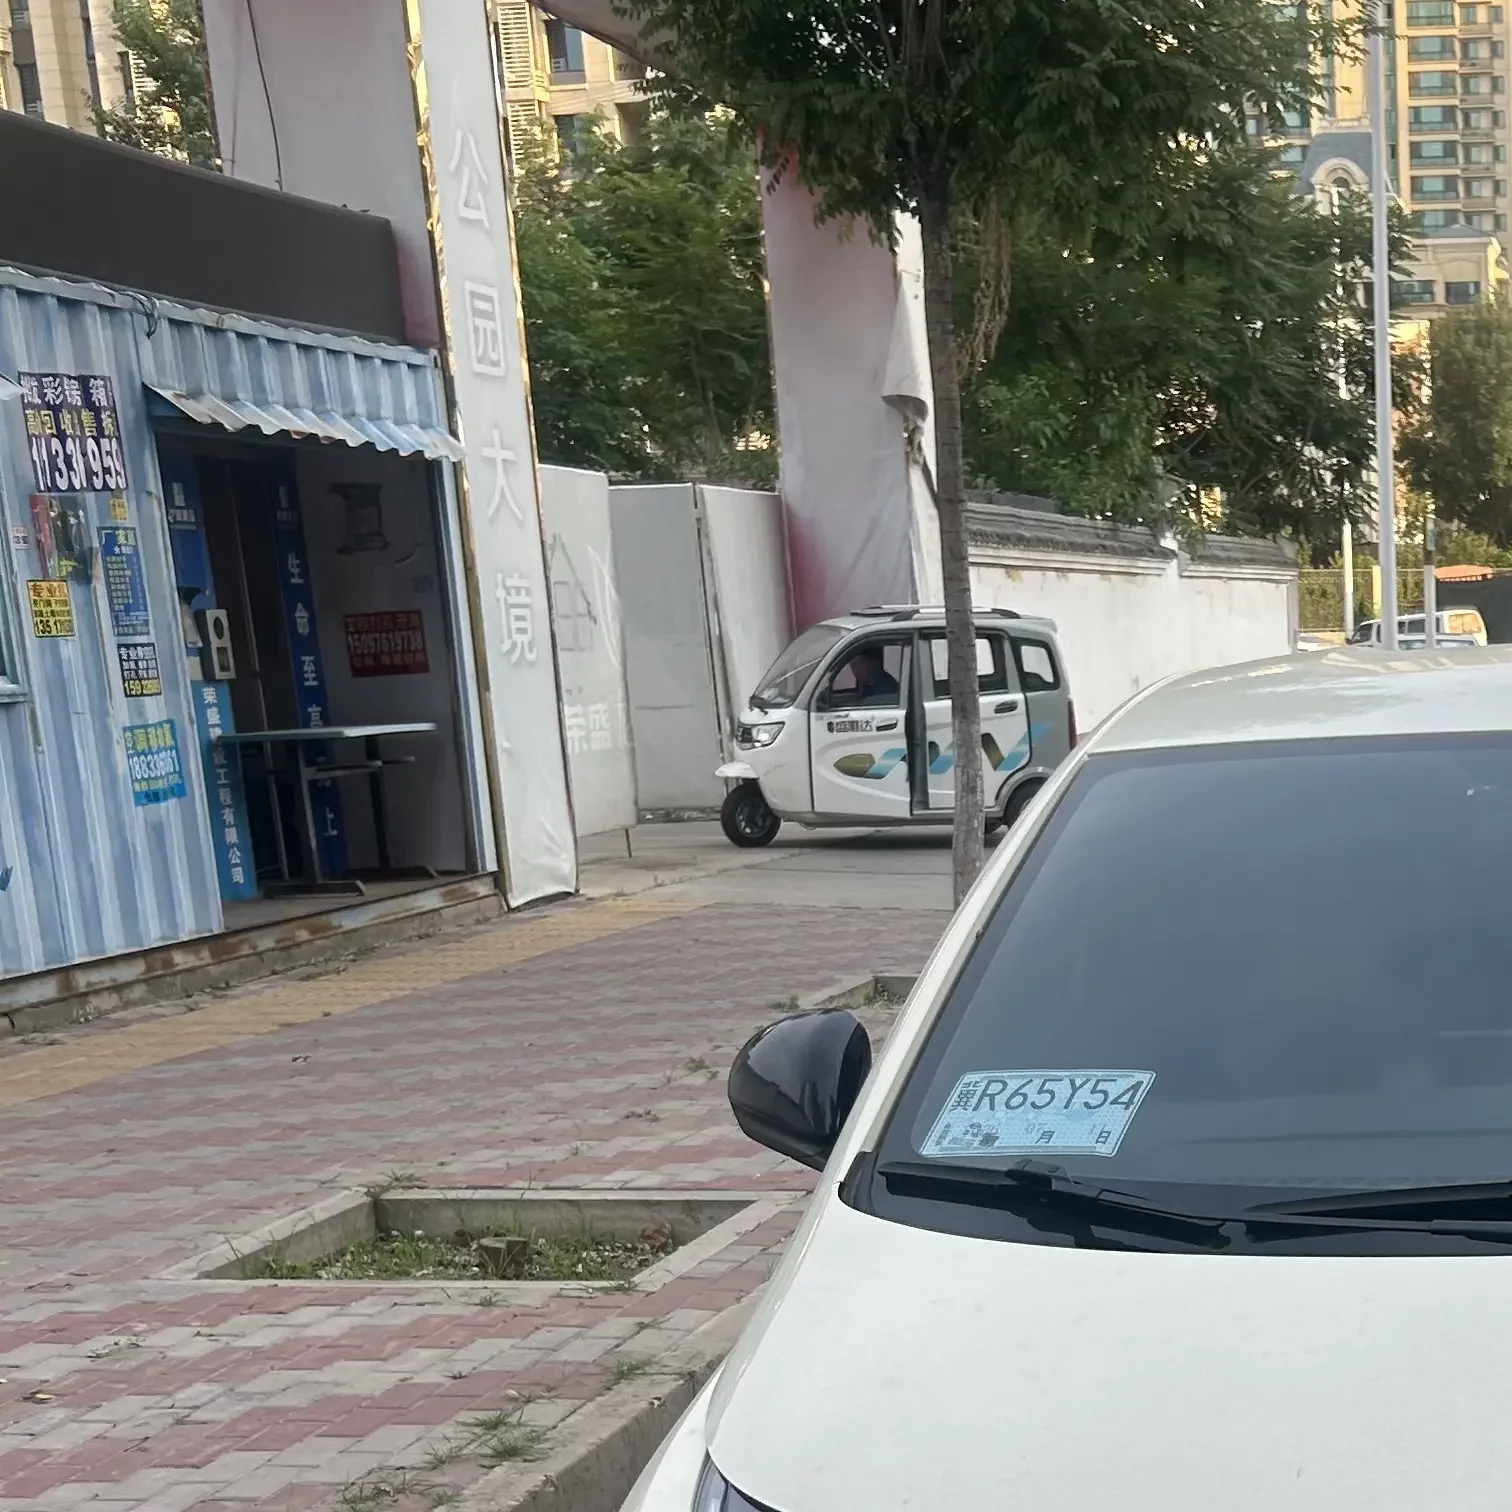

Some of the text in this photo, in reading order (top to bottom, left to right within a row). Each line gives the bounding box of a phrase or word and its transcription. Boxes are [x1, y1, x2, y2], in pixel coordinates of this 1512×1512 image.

[448, 127, 538, 666] 公园大境
[950, 1078, 1145, 1111] 冀R65Y54
